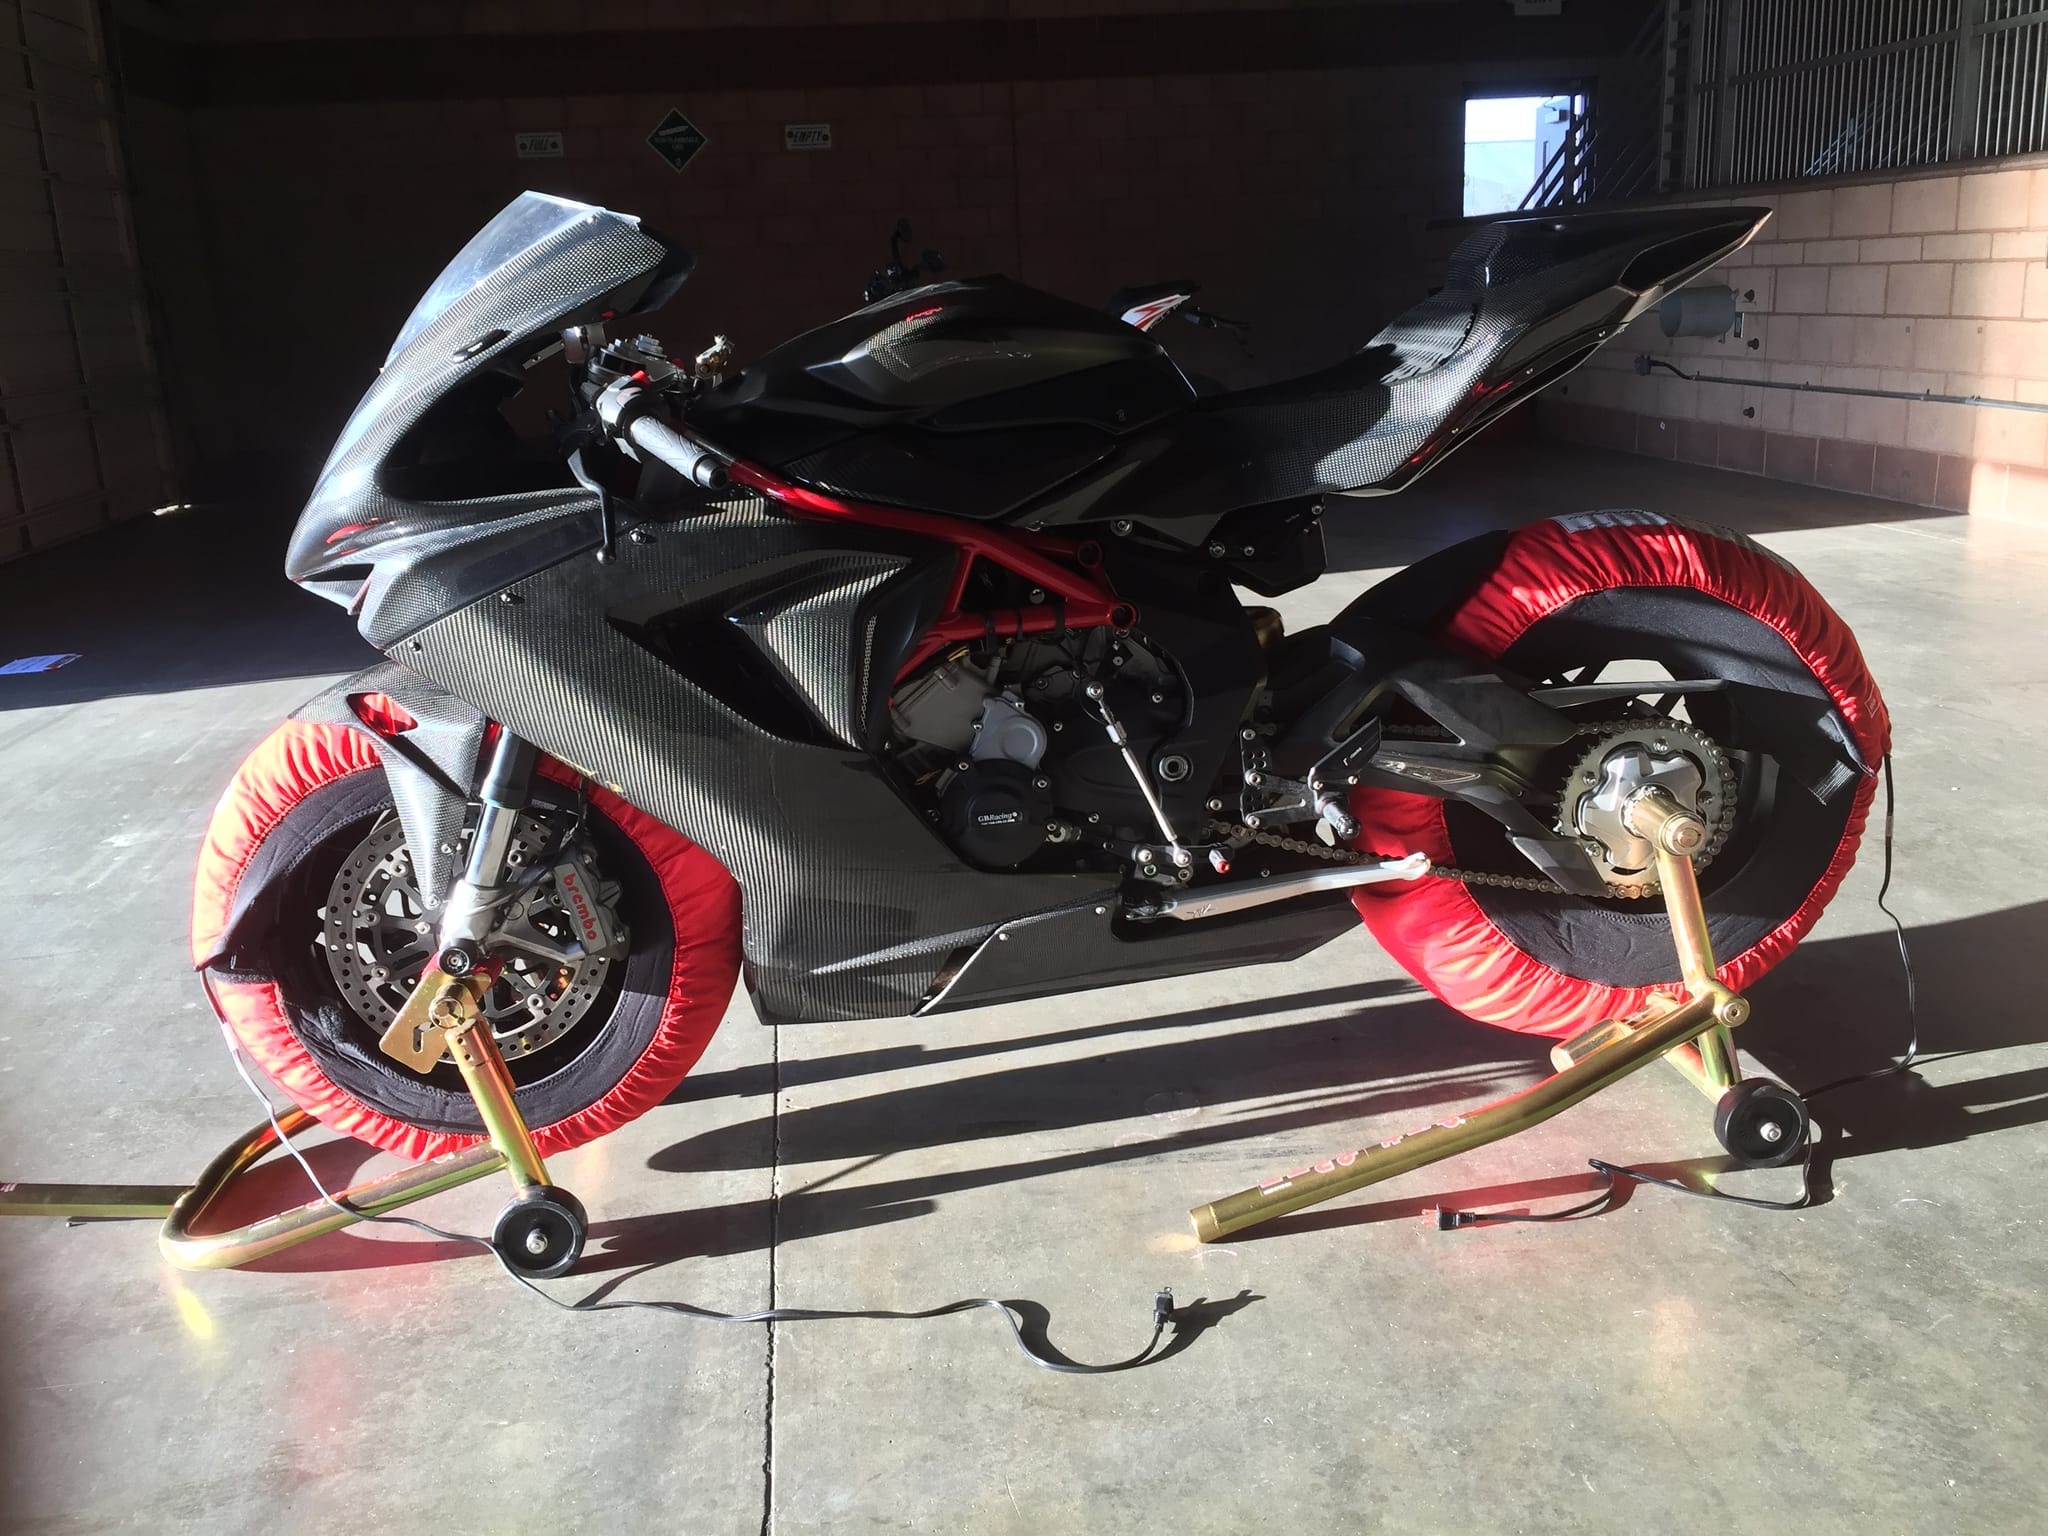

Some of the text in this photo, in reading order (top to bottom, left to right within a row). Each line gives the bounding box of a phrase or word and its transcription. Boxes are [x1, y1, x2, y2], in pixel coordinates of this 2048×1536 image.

[793, 130, 822, 143] EMPTY
[528, 138, 549, 151] FULL
[978, 812, 1013, 822] GBRacing
[564, 873, 597, 940] brembo
